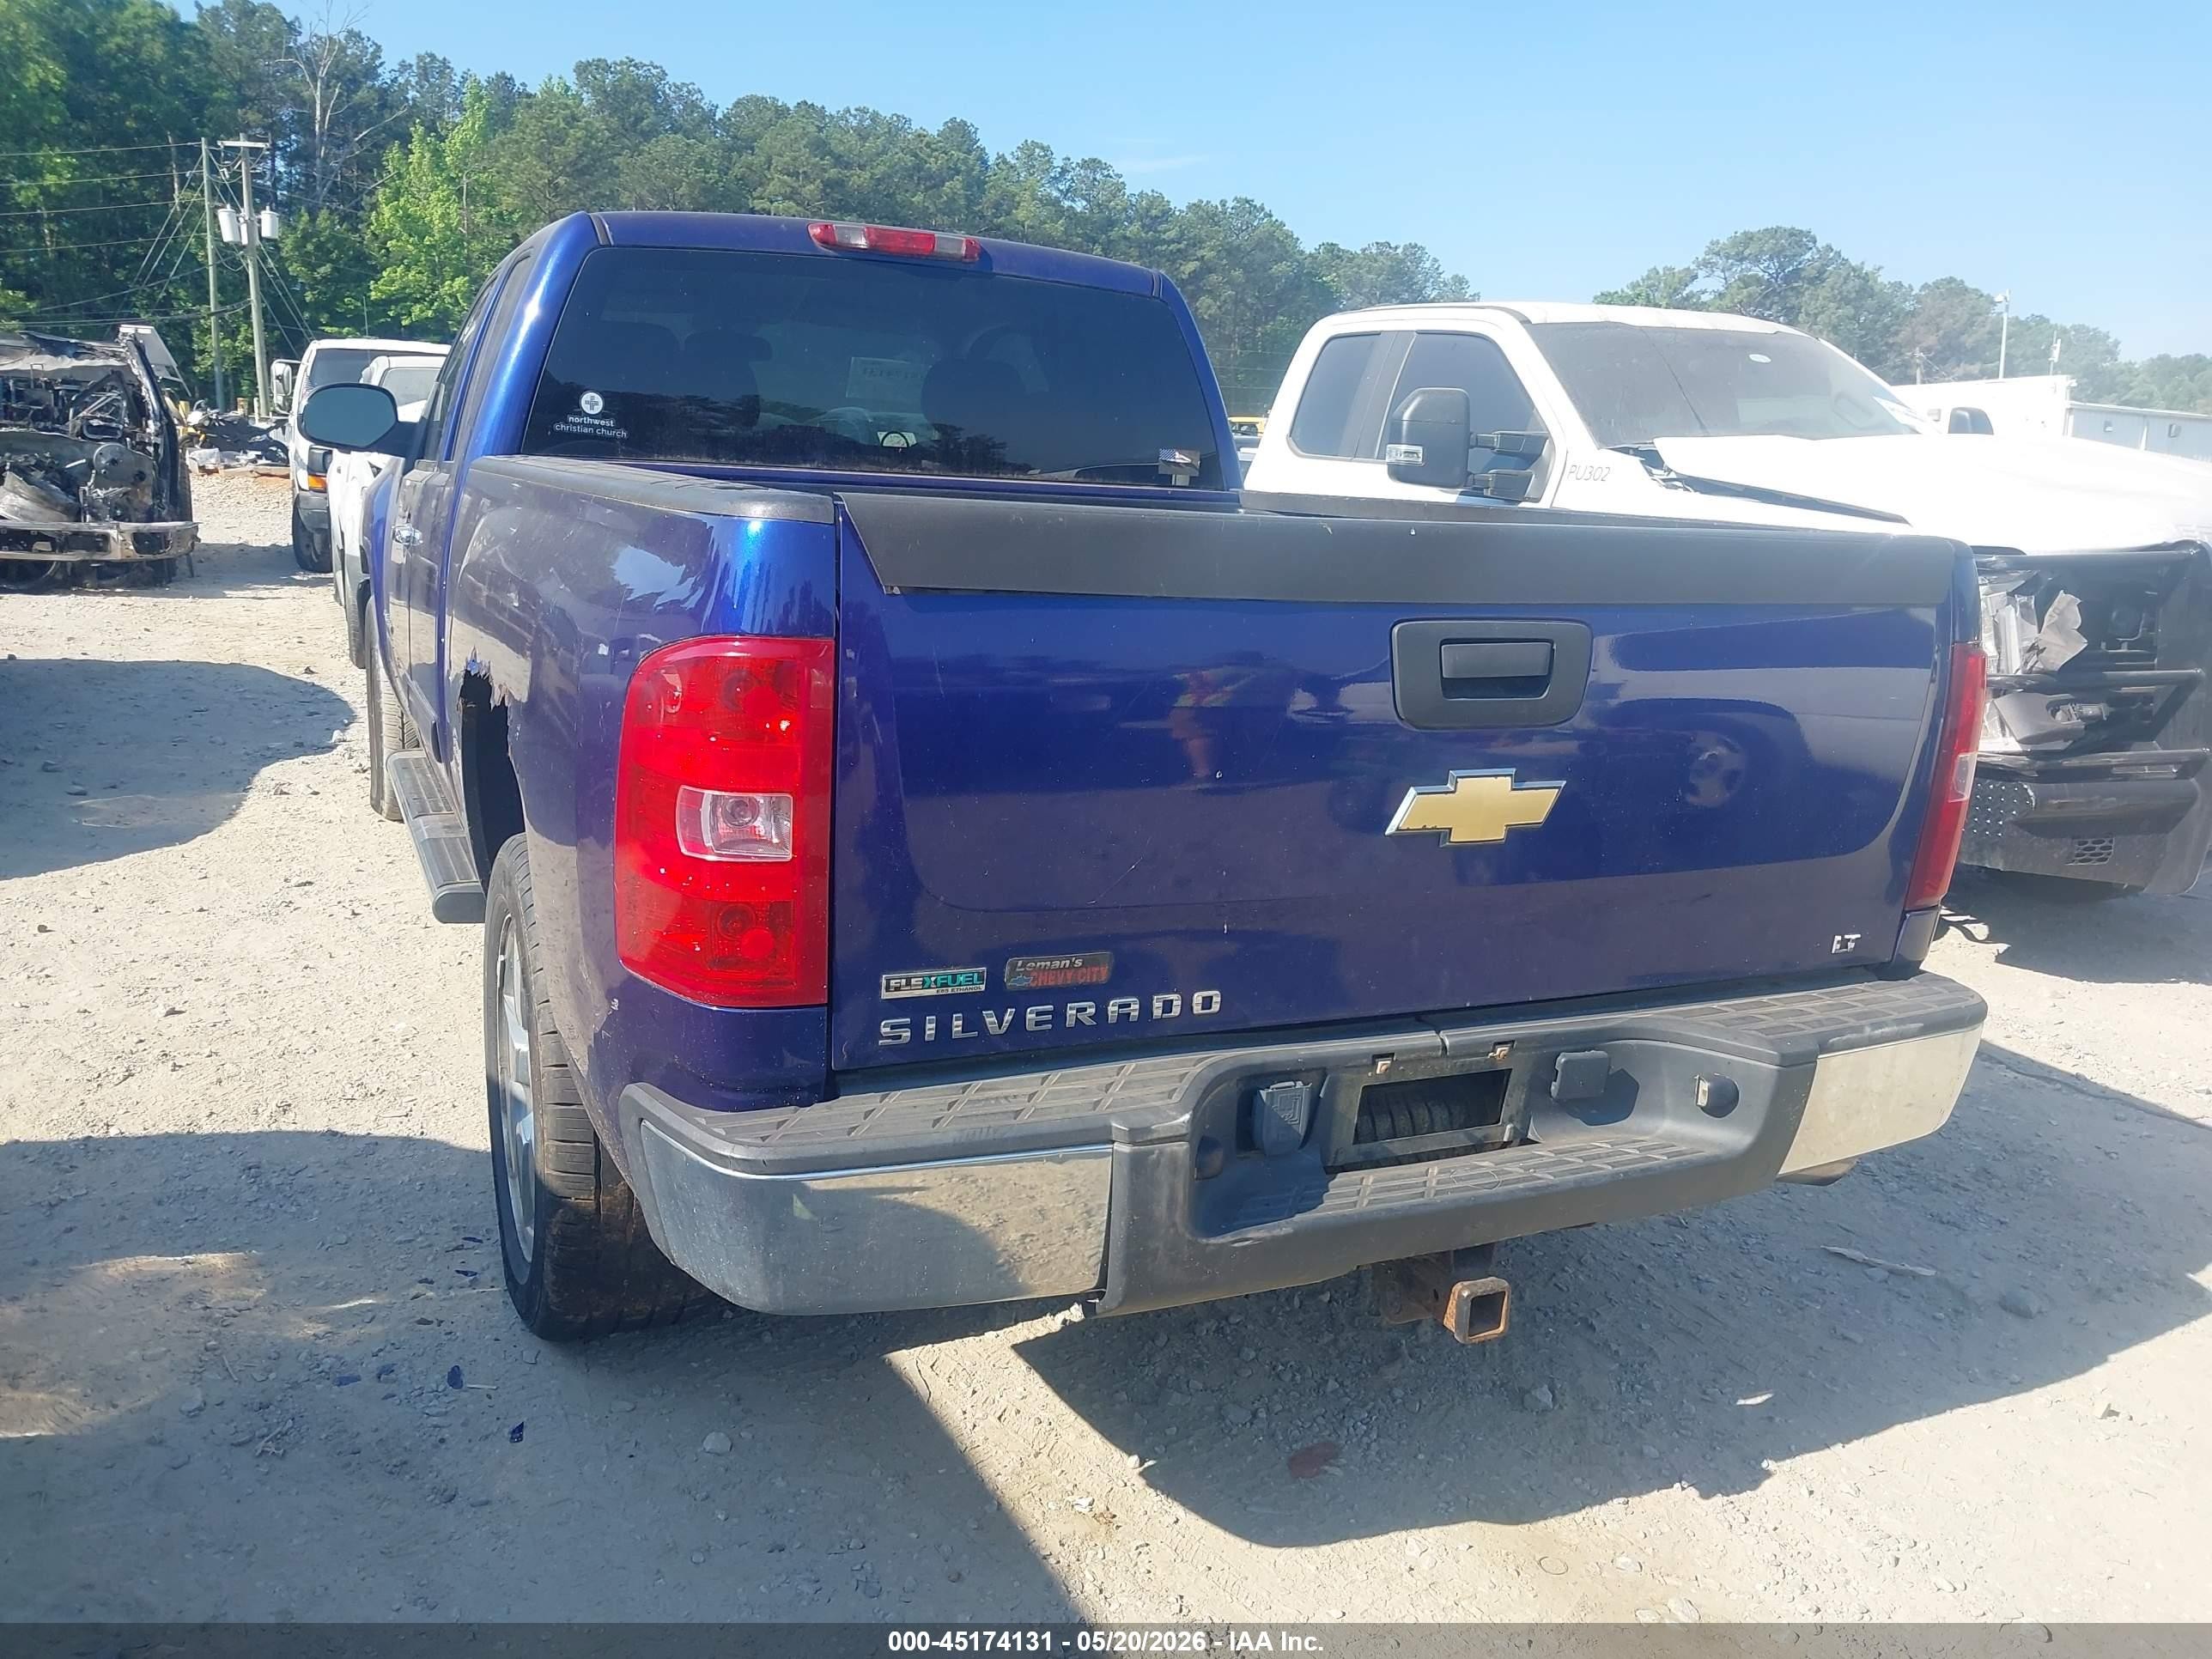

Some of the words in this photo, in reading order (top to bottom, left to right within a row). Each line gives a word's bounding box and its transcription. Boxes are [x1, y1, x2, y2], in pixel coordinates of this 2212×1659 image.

[568, 416, 614, 427] northwest
[555, 423, 594, 434] christian
[596, 428, 627, 438] church
[1567, 465, 1611, 482] PU302
[1831, 933, 1862, 954] LT
[1016, 957, 1084, 971] Leman's
[890, 972, 983, 991] FLEXFUEL
[878, 989, 1222, 1046] SILVERADO
